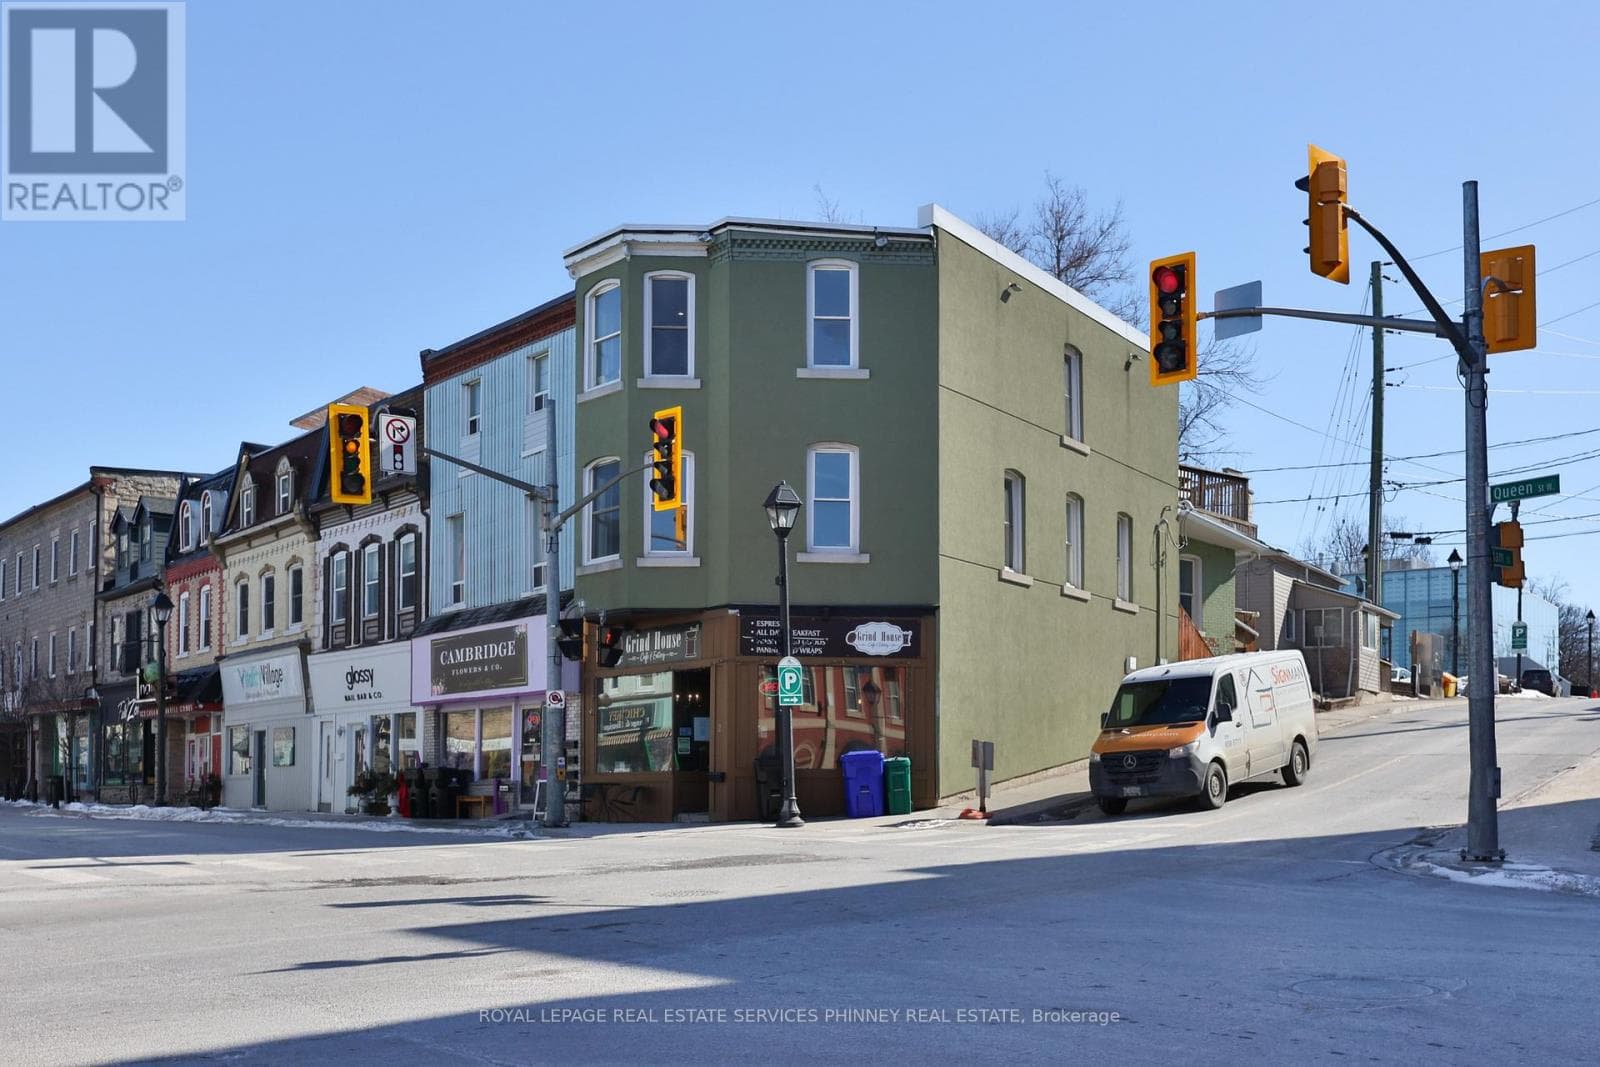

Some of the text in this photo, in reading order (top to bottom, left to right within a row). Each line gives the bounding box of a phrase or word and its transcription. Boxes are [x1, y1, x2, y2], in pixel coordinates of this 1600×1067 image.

[1493, 484, 1533, 499] Queen
[625, 631, 682, 653] Grind House
[857, 631, 902, 642] Grind House
[440, 640, 516, 665] CAMBRIDGE
[345, 665, 374, 690] glossy
[451, 664, 482, 676] FLOWERS
[785, 672, 797, 690] P
